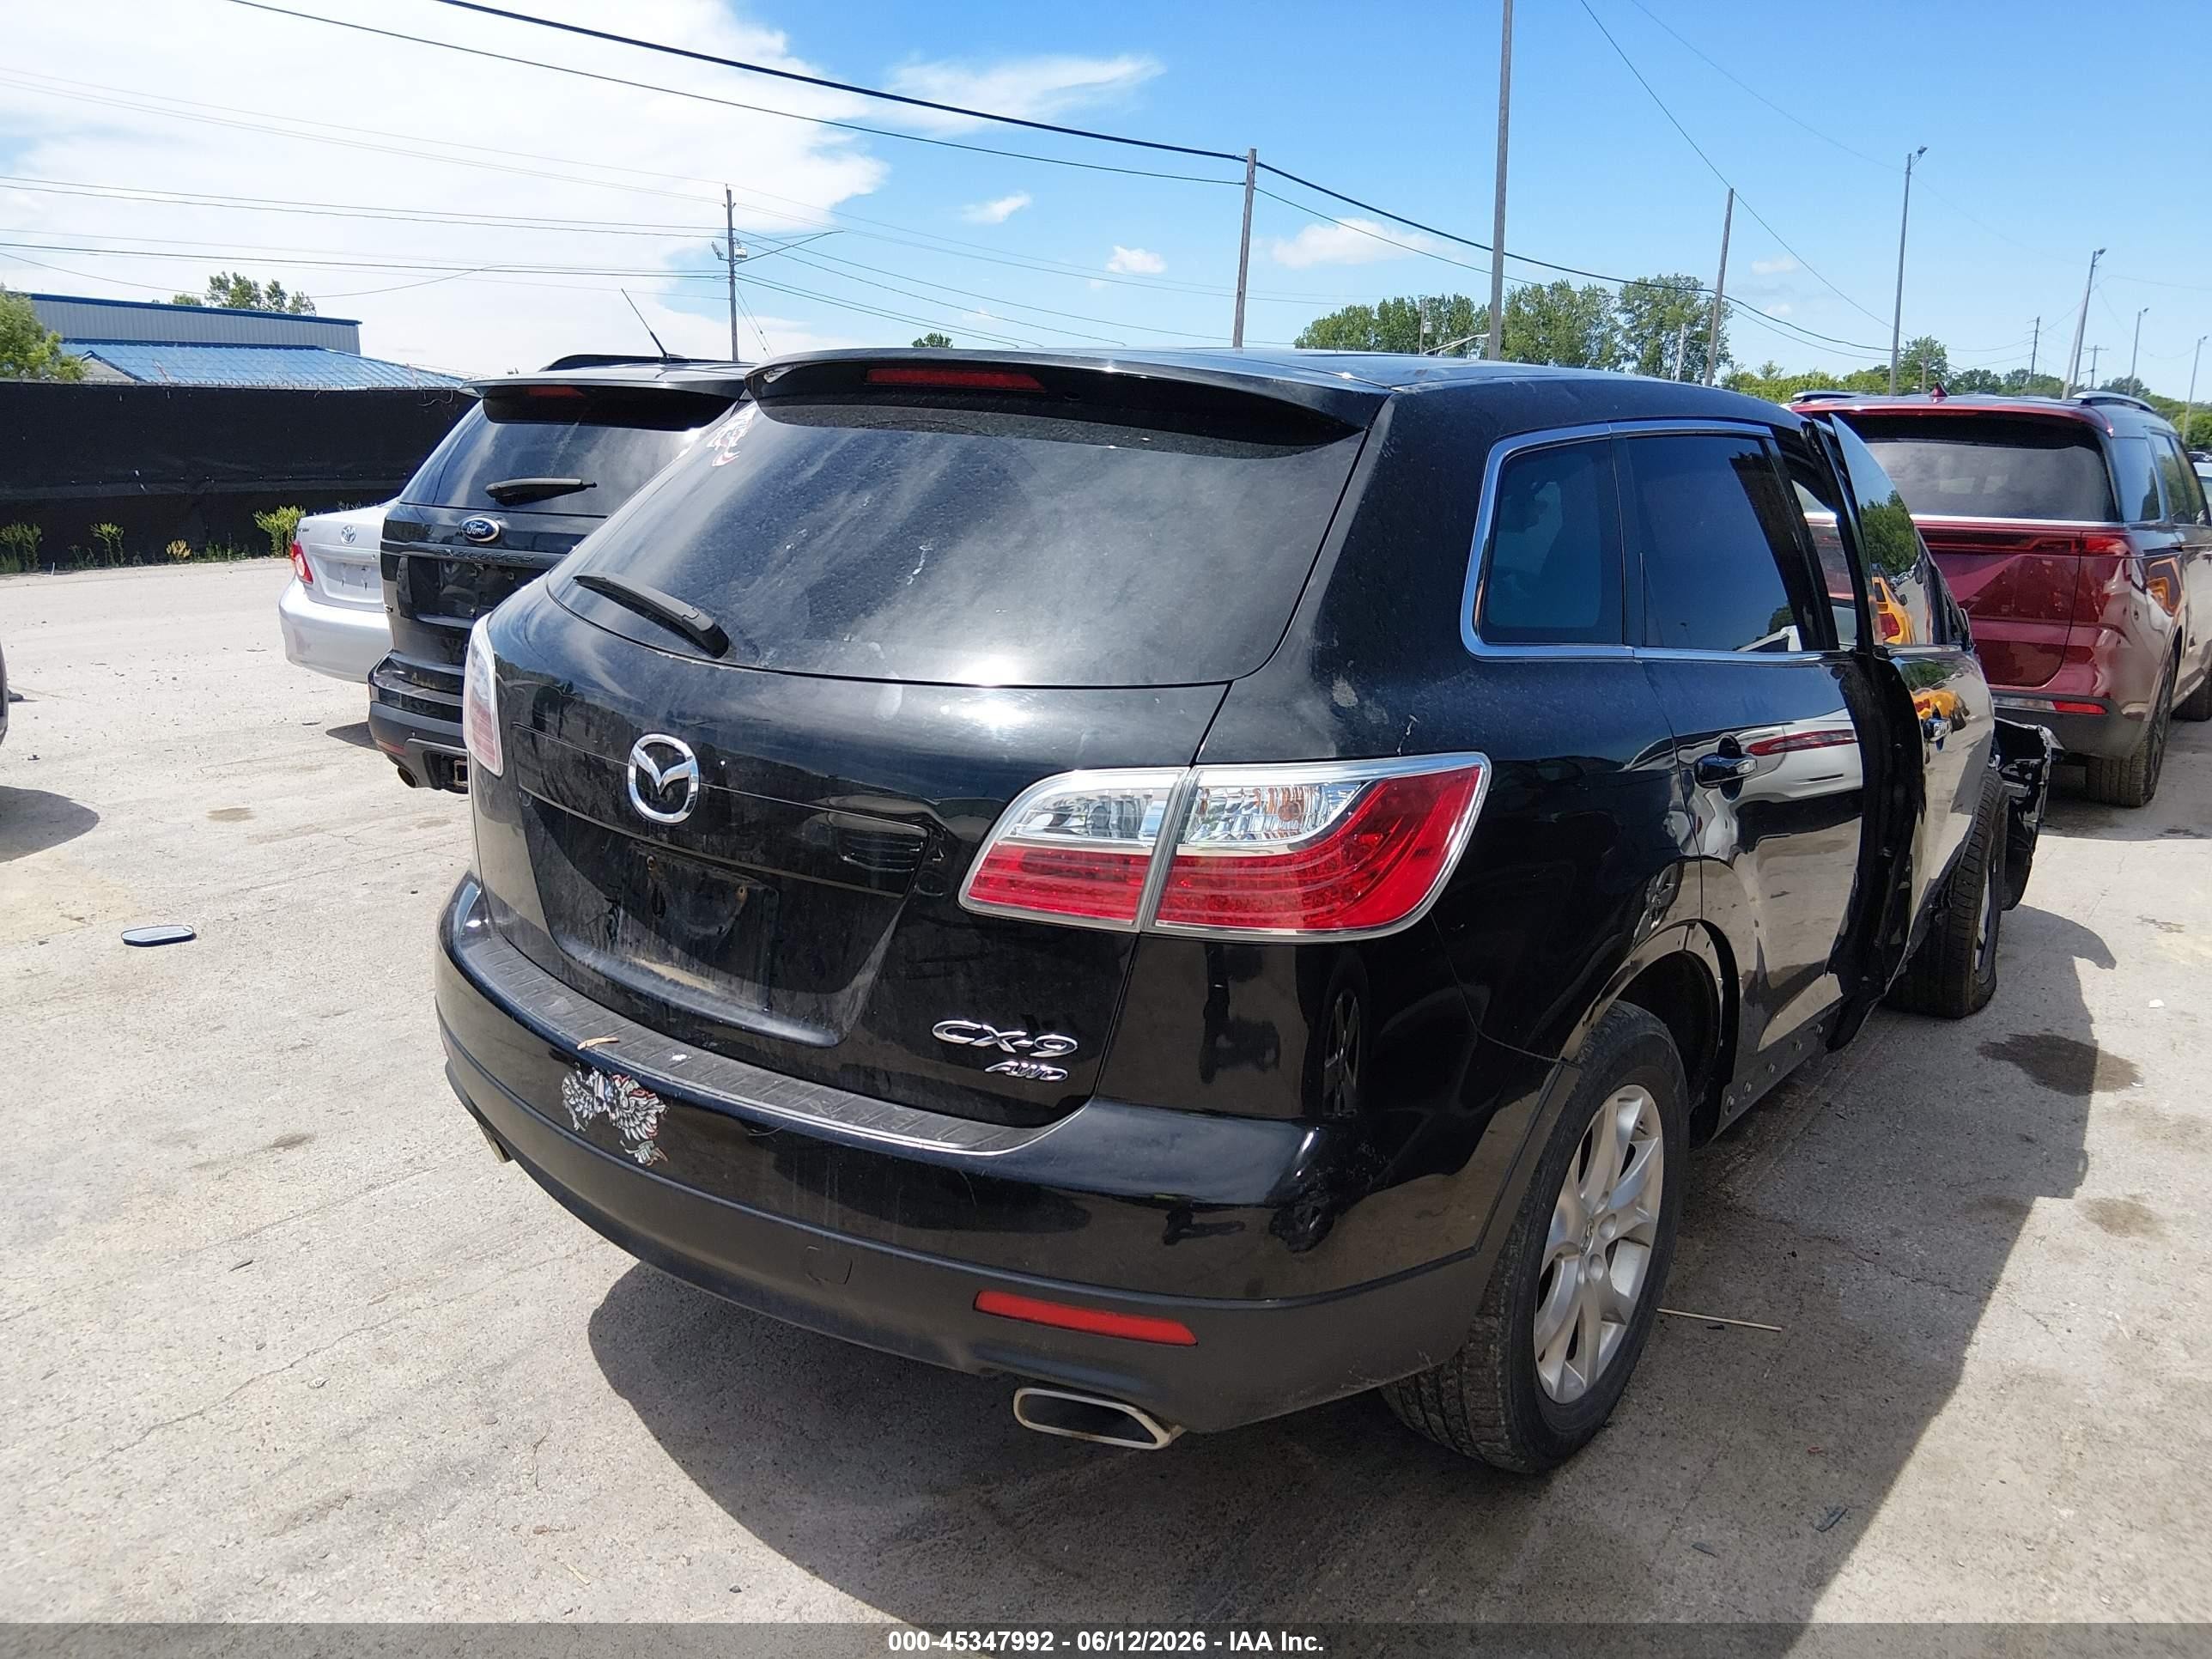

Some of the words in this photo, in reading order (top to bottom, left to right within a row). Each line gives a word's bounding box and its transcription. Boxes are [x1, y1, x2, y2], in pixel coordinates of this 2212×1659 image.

[466, 520, 489, 536] Ford
[932, 1019, 1079, 1058] CX-9
[984, 1060, 1068, 1082] AWD
